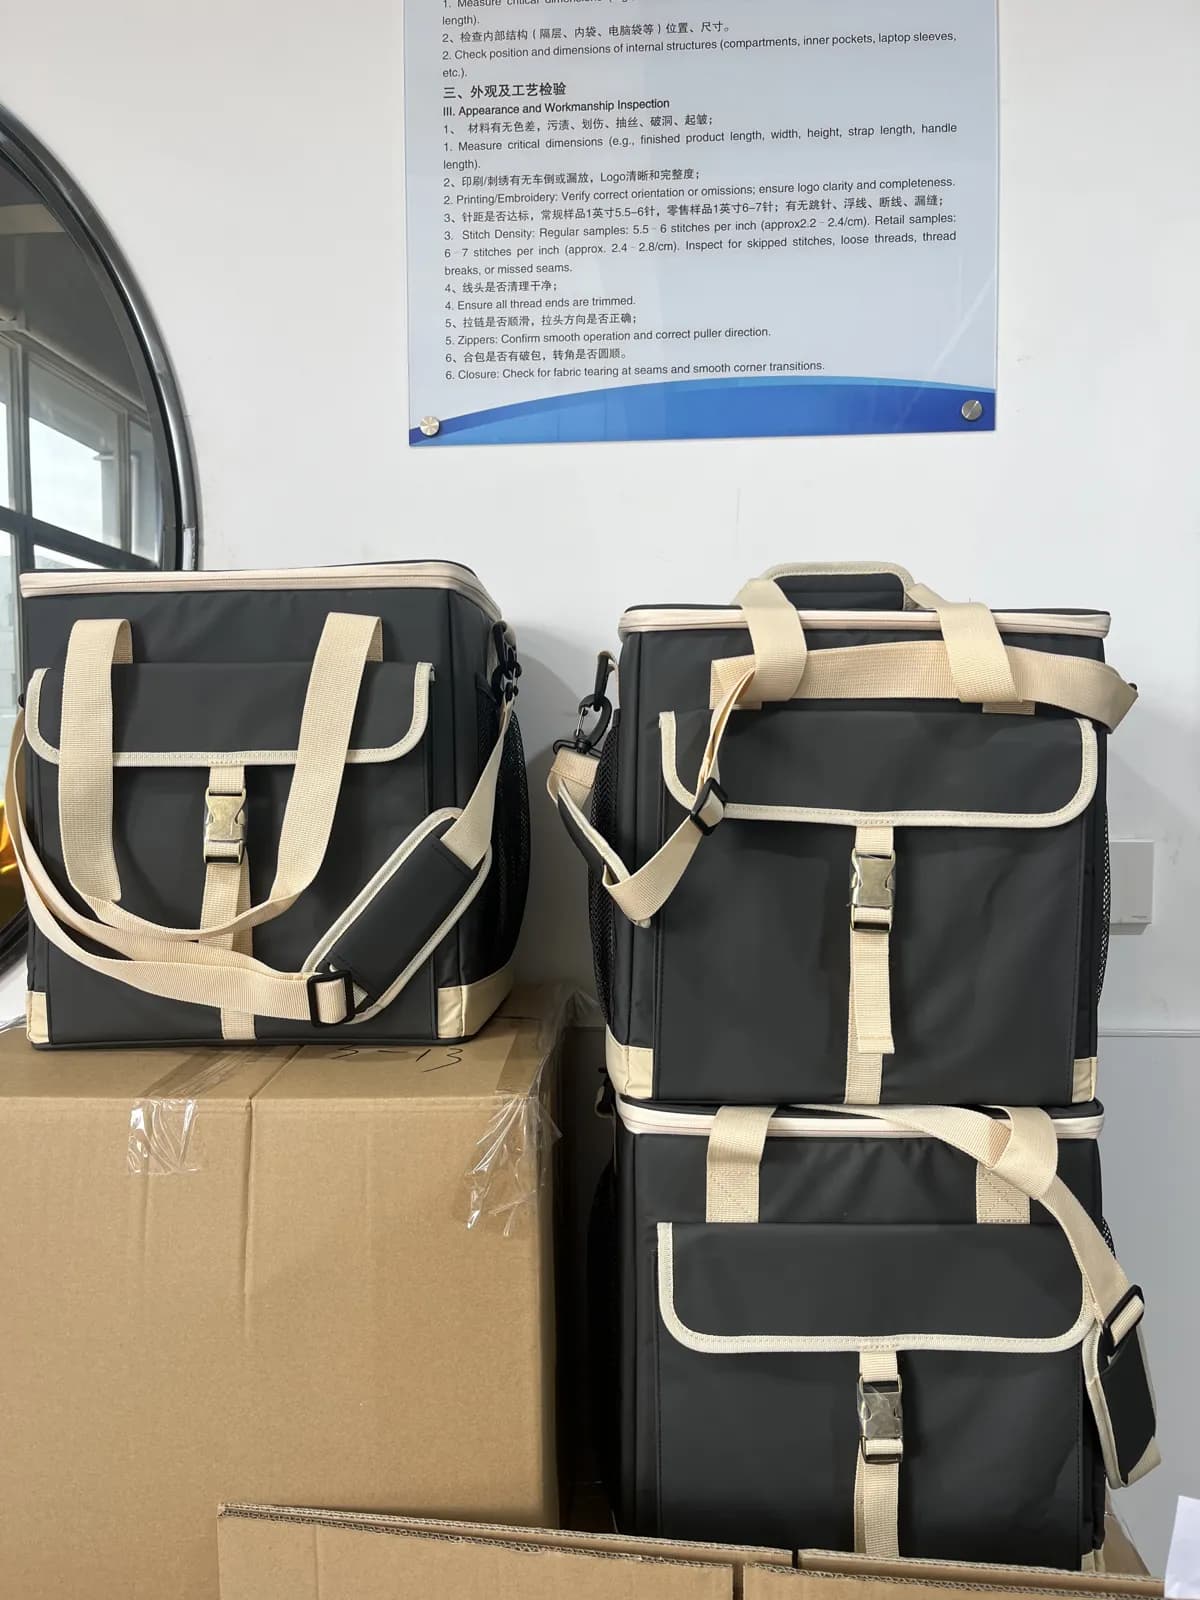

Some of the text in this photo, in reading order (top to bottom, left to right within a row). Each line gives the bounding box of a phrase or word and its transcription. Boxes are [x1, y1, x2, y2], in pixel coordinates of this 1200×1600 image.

[442, 15, 480, 27] length).
[442, 31, 957, 61] 2. Check position and dimensions of internal structures (compartments, inner pockets, laptop sleeves,
[442, 67, 467, 79] etc.).
[443, 81, 567, 100] 三、外观及工艺检验
[443, 98, 670, 118] III. Appearance and Workmanship Inspection
[444, 122, 957, 152] 1. Measure critical dimensions (e.g., finished product length, width, height, strap length, handle
[443, 159, 481, 171] length).
[443, 177, 955, 206] 2. Printing/Embroidery: Verify correct orientation or omissions; ensure logo clarity and completeness.
[444, 231, 453, 240] 3.
[462, 229, 490, 240] Stitch
[494, 228, 535, 240] Density:
[539, 226, 578, 239] Regular
[583, 225, 629, 239] samples:
[671, 222, 710, 233] stitches
[714, 222, 731, 233] per
[735, 220, 757, 230] inch
[761, 217, 817, 231] (approx2.2
[827, 216, 870, 228] 2.4/cm).
[875, 214, 905, 225] Retail
[909, 212, 956, 226] samples:
[473, 247, 512, 257] stitches
[517, 247, 533, 258] per
[538, 245, 559, 255] inch
[564, 244, 606, 256] (approx.
[638, 240, 680, 252] 2.8/cm).
[685, 239, 722, 251] Inspect
[728, 238, 742, 249] for
[747, 237, 787, 249] skipped
[792, 236, 835, 247] stitches,
[840, 234, 869, 245] loose
[874, 232, 917, 243] threads,
[922, 230, 957, 241] thread
[444, 263, 572, 276] breaks, or missed seams.
[444, 295, 636, 310] 4. Ensure all thread ends are trimmed.
[445, 327, 771, 347] 5. Zippers: Confirm smooth operation and correct puller direction.
[445, 360, 825, 380] 6. Closure: Check for fabric tearing at seams and smooth corner transitions.
